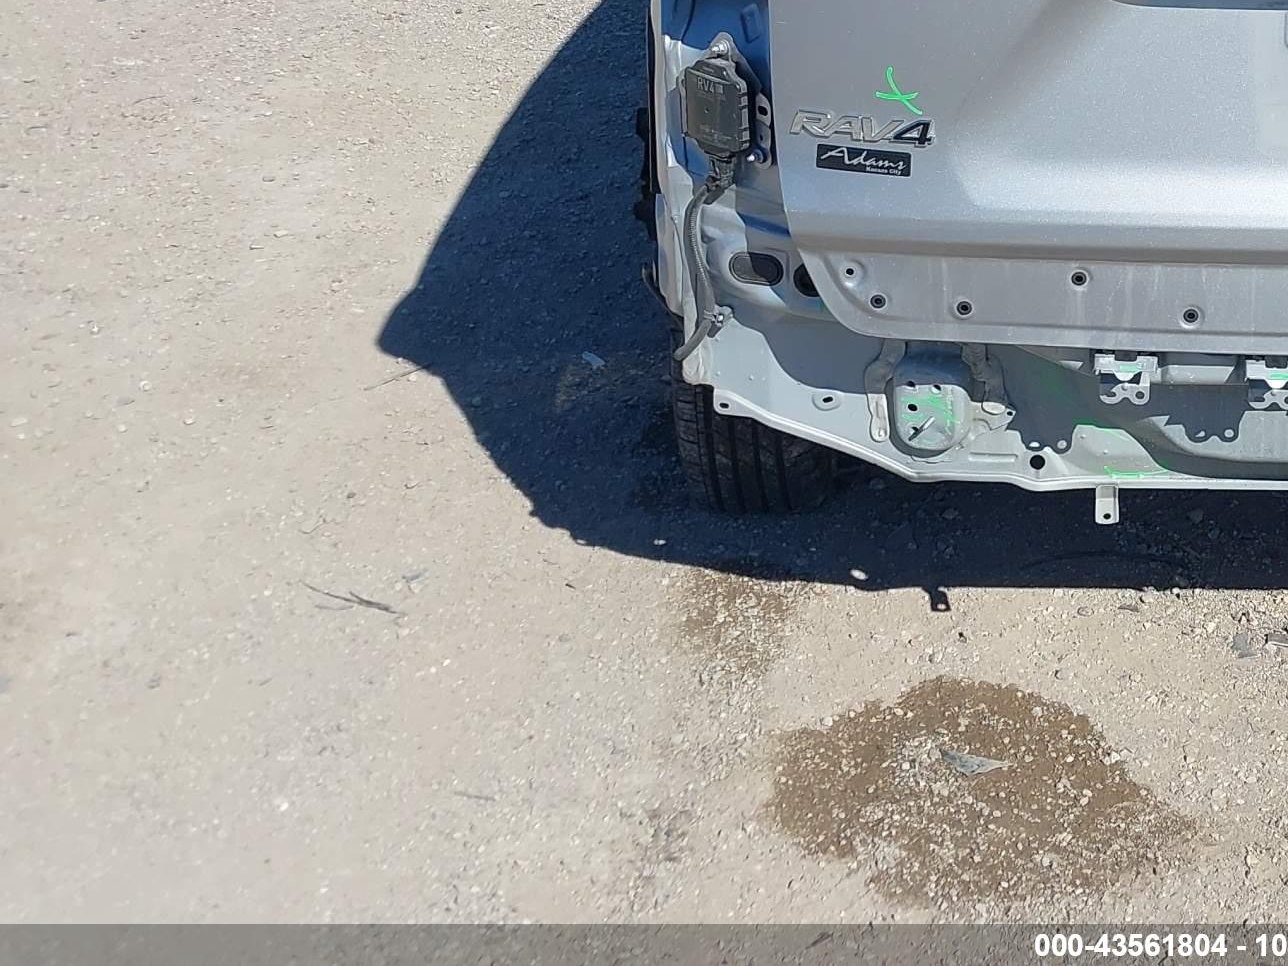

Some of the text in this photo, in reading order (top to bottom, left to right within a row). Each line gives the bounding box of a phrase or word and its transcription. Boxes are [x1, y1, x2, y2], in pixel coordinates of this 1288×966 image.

[789, 109, 936, 148] RAV4
[820, 146, 907, 170] Adams
[865, 166, 902, 176] Kansas City
